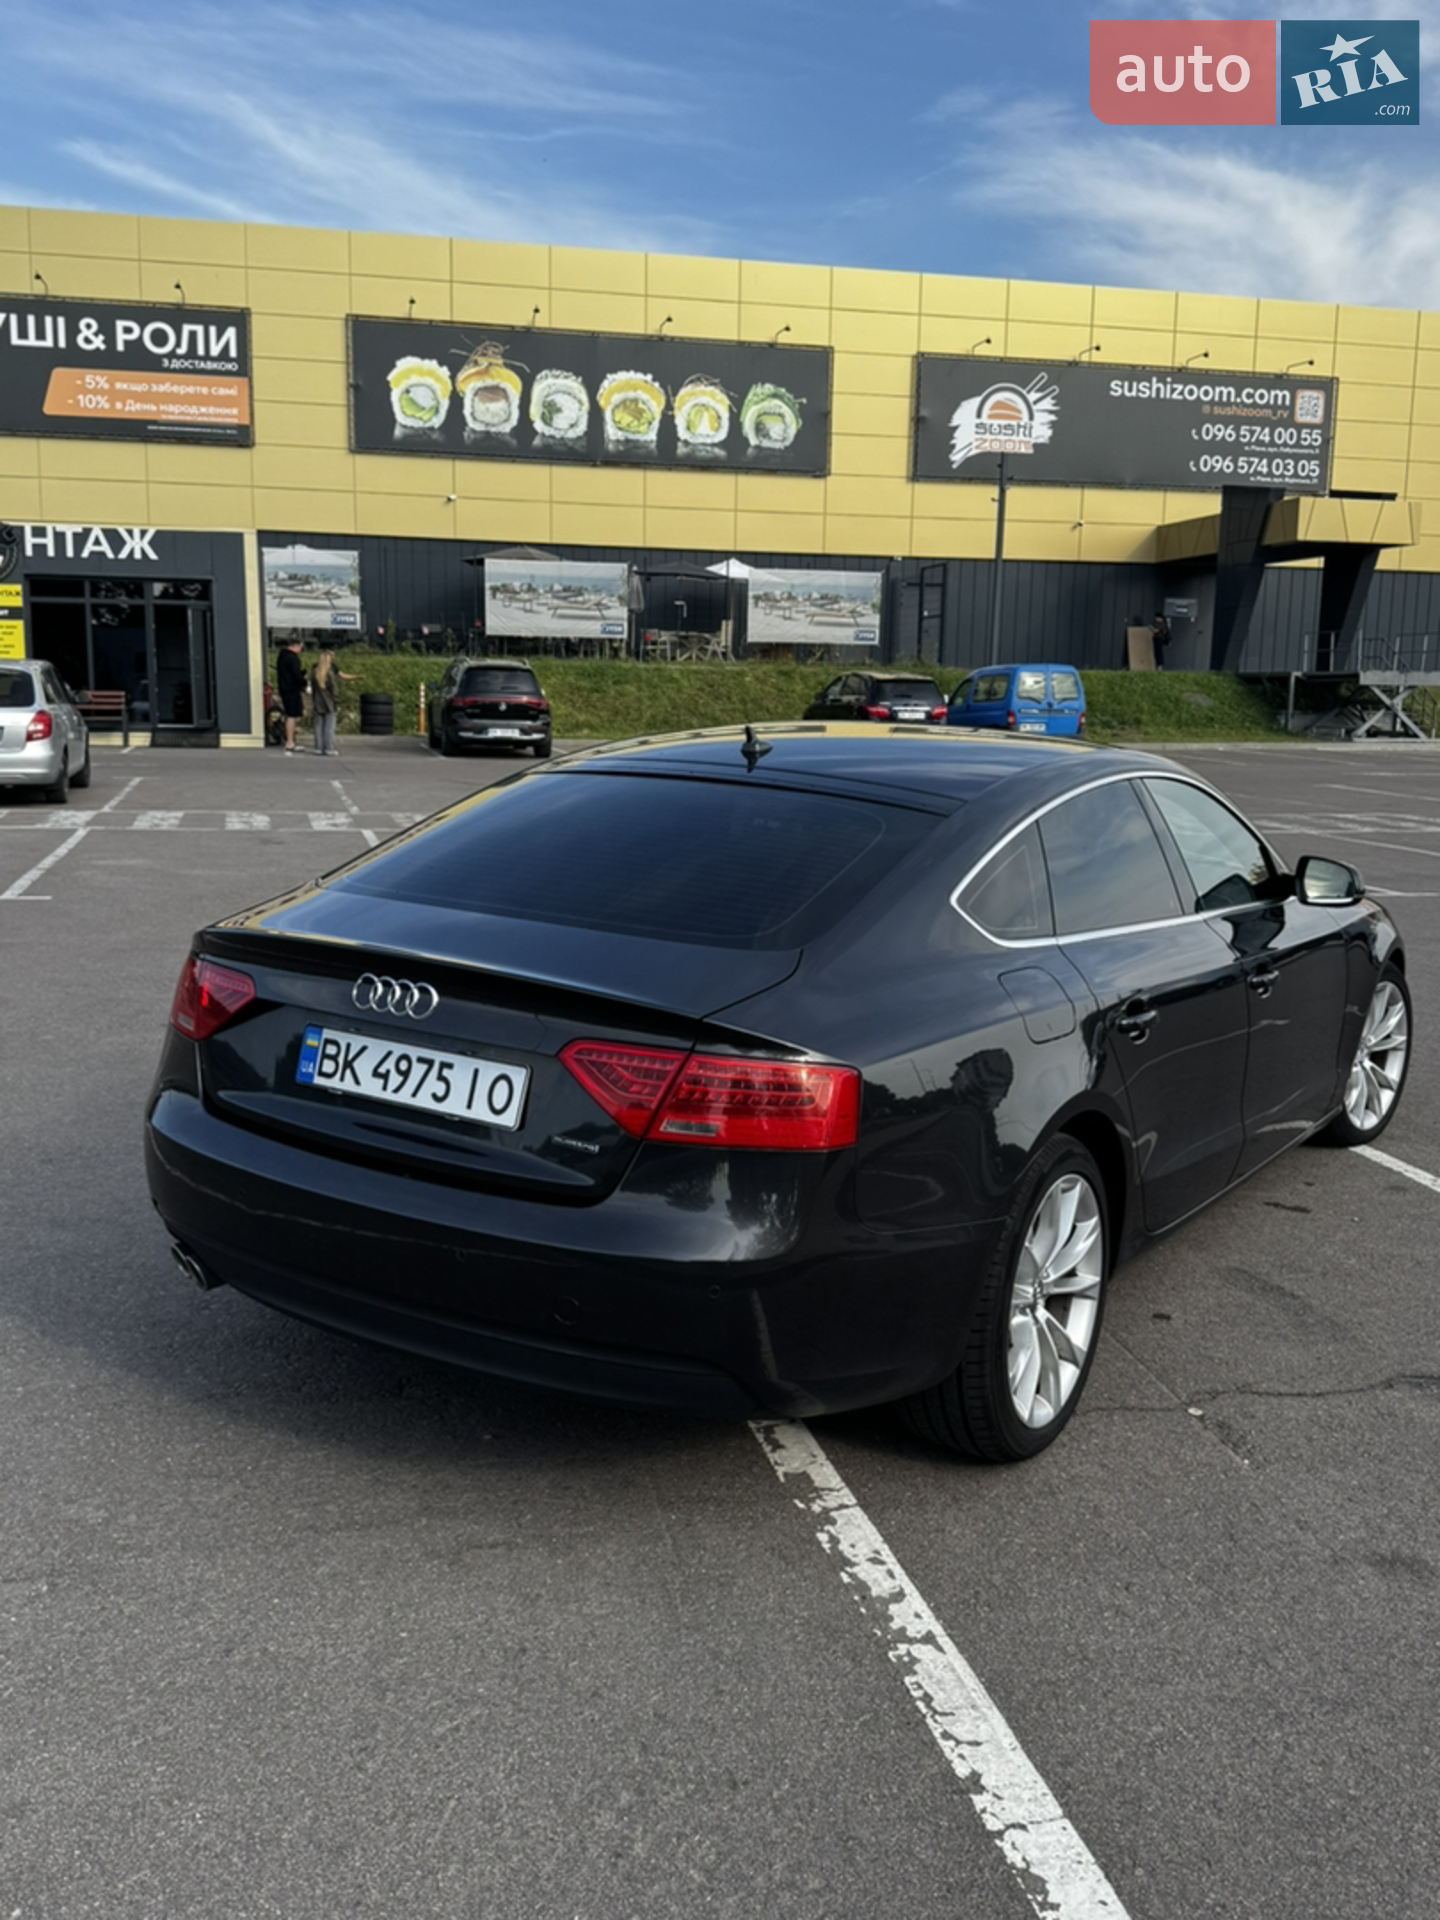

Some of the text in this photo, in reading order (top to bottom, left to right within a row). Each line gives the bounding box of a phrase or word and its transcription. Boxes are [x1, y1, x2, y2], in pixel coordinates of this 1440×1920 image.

[76, 317, 106, 351] &
[115, 319, 238, 358] РОЛИ
[170, 360, 239, 371] ДОСТАВКОЮ
[85, 374, 110, 390] 5%
[114, 381, 148, 393] якщо
[151, 381, 208, 395] заберете
[211, 384, 238, 396] самі
[1109, 377, 1290, 406] sushizoom.com
[76, 394, 110, 410] 10%
[124, 399, 157, 412] День
[160, 402, 238, 416] народження
[1212, 404, 1289, 420] sushizoom_rv
[1201, 423, 1322, 446] 096 574 00 55
[1199, 454, 1320, 477] 096 574 03 05
[301, 1061, 314, 1074] UA
[316, 1037, 369, 1086] BK
[371, 1050, 454, 1104] 4975
